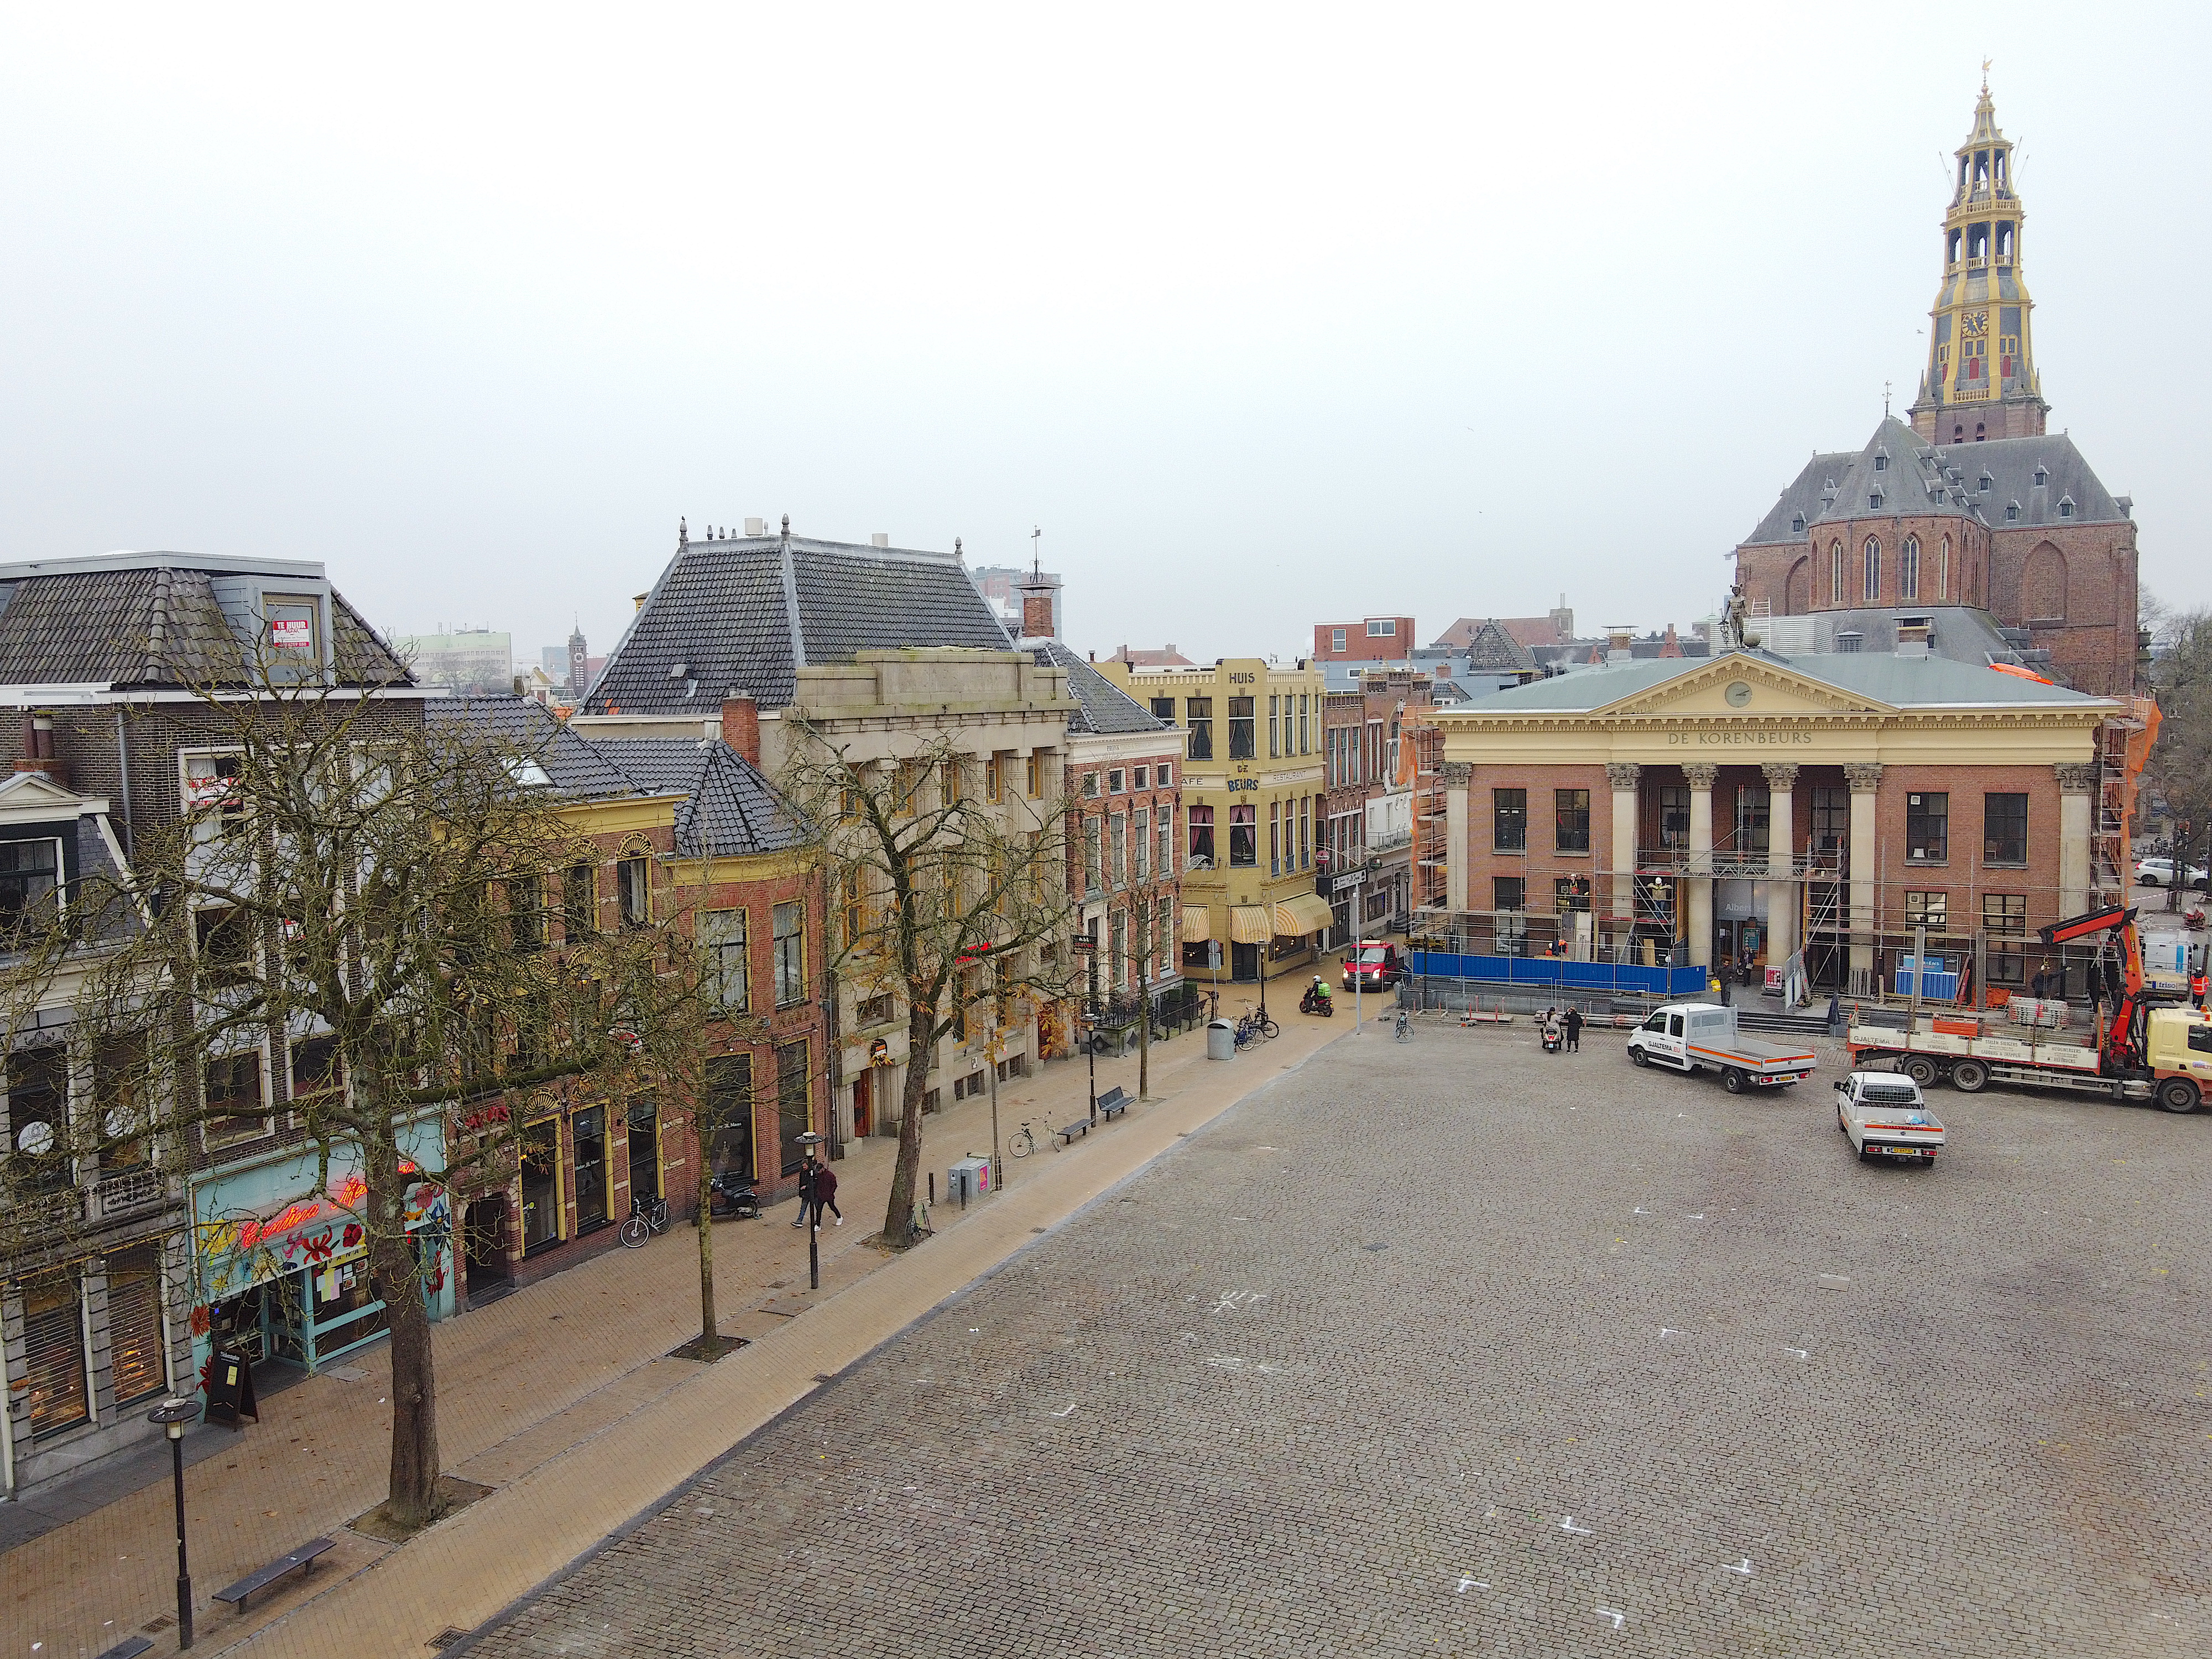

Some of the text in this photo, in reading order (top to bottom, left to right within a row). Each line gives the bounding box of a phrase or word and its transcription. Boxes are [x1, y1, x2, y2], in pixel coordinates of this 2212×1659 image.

[1229, 672, 1255, 684] HUIS
[1668, 733, 1812, 744] DE KORENBEURS
[1181, 776, 1203, 785] AFÉ
[1273, 771, 1306, 781] RESTAURANT
[1227, 778, 1259, 792] BEURS
[1725, 903, 1751, 911] Albert
